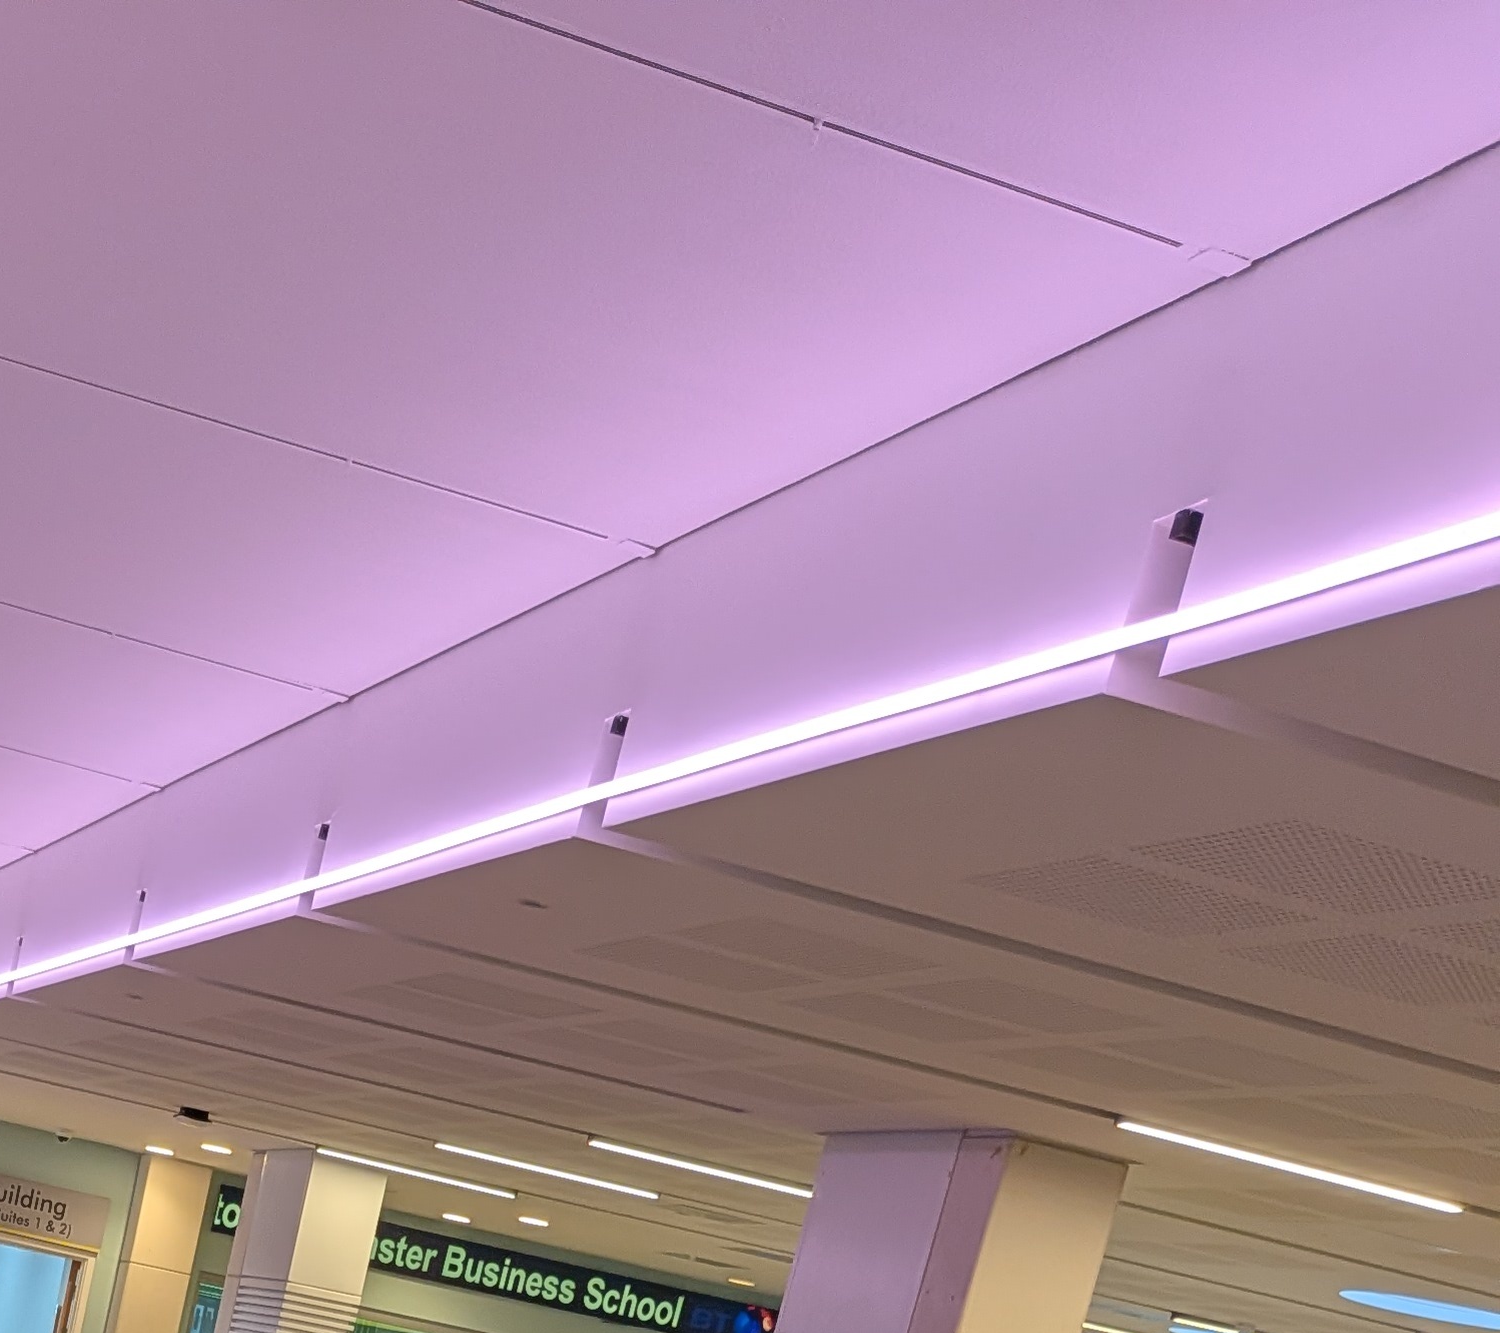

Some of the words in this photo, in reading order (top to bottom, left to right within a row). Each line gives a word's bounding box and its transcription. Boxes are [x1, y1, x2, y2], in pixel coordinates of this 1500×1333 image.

[35, 1217, 41, 1229] 1
[45, 1220, 55, 1233] &
[59, 1223, 72, 1239] 2)
[213, 1193, 241, 1229] to
[442, 1244, 576, 1304] Business
[583, 1277, 685, 1328] School
